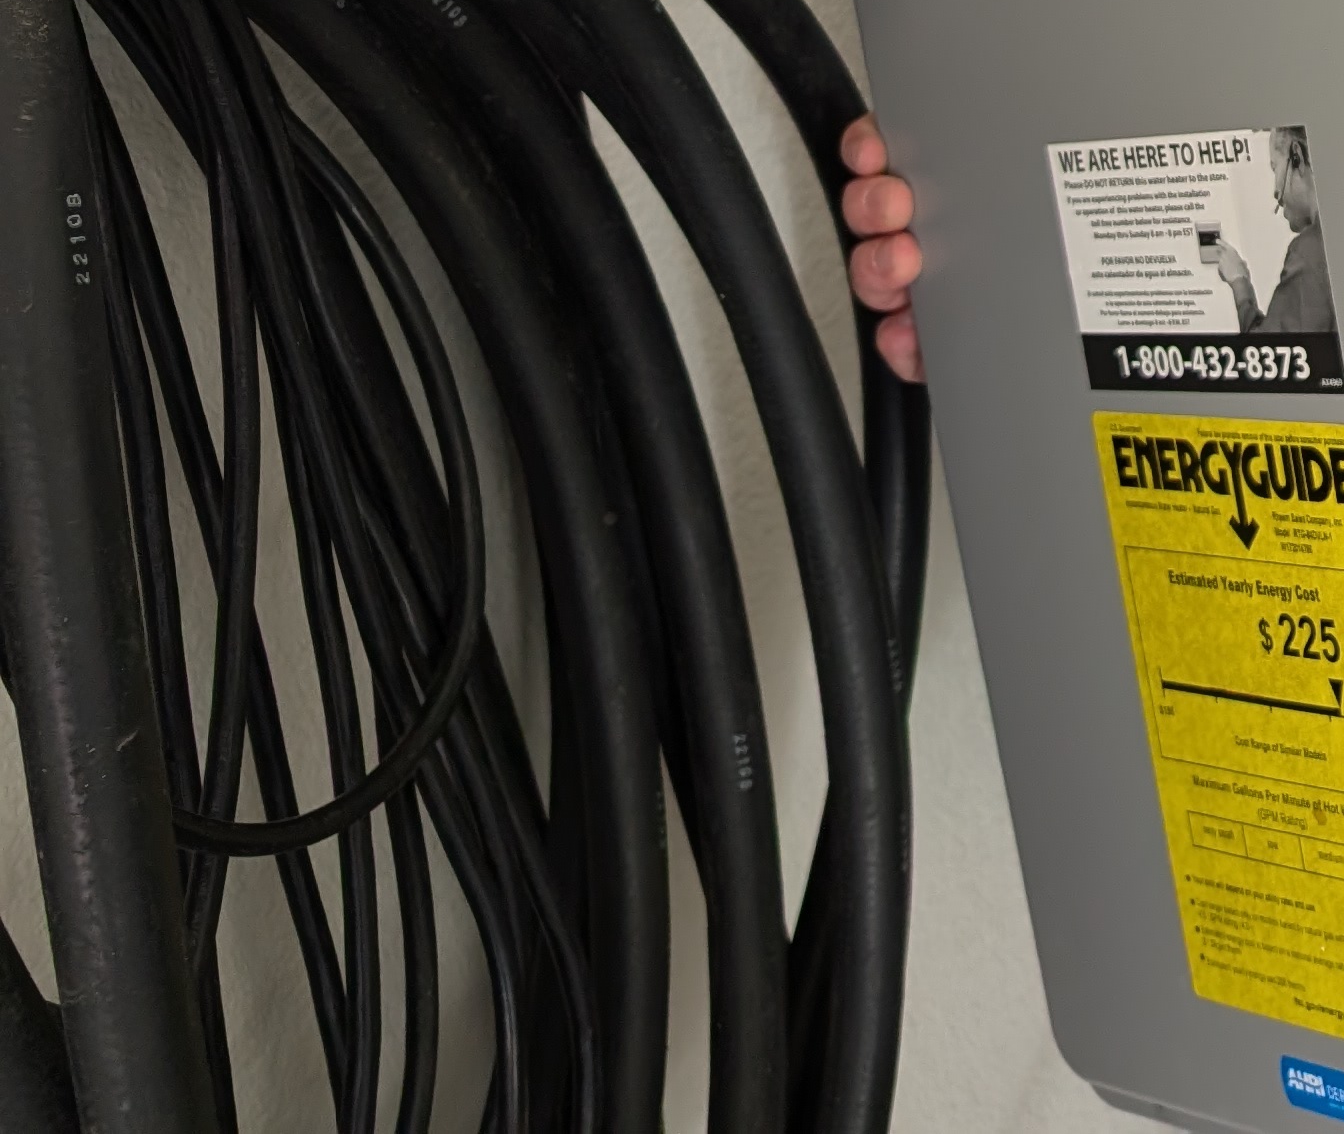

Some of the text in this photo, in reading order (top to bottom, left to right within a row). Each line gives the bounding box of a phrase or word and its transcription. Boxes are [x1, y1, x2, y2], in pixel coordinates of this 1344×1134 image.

[1058, 137, 1251, 173] WE ARE HERE TO HELP!
[1115, 345, 1311, 380] 1-800-432-8373
[1168, 570, 1321, 602] Estimated Yearly Energy Cost
[1258, 612, 1341, 663] $ 225
